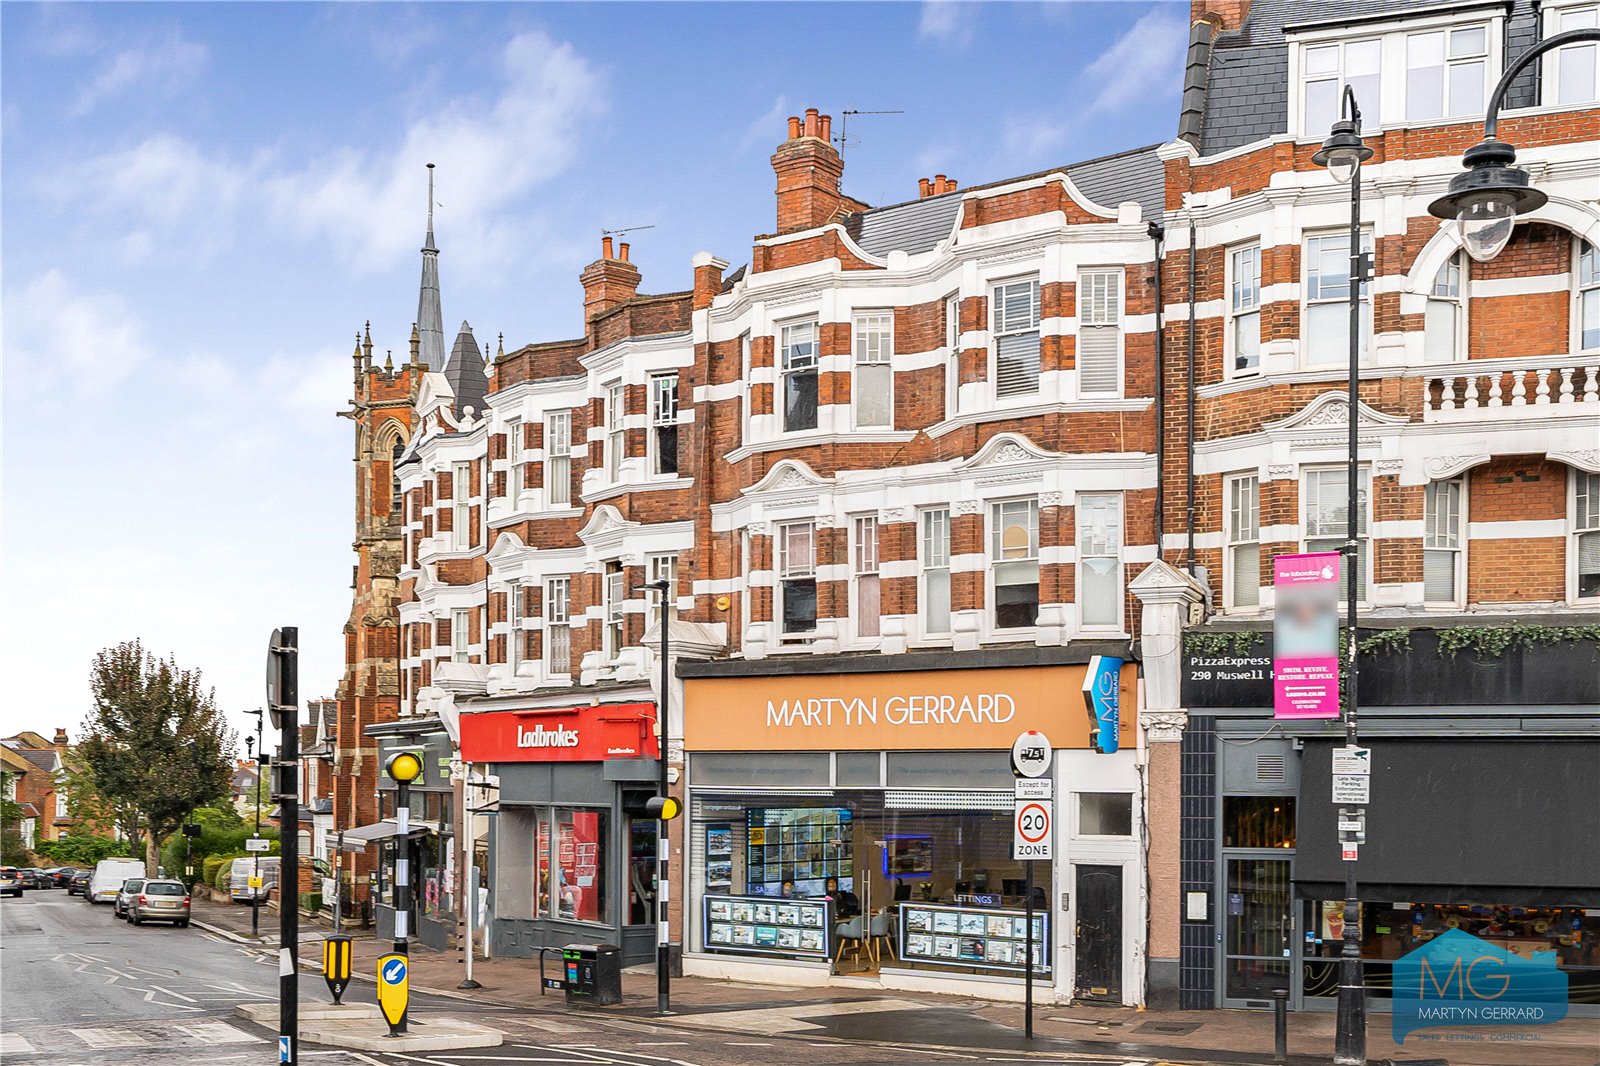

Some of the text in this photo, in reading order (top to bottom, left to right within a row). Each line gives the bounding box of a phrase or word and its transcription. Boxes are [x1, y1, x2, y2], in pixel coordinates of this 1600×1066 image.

[1190, 657, 1271, 668] PizzaExpress
[1190, 671, 1212, 680] 290
[1216, 669, 1264, 680] Muswell
[1098, 671, 1113, 722] MG
[765, 693, 1016, 727] MARTYN GERRARD
[517, 723, 579, 748] Ladbrokes
[1018, 780, 1050, 789] Except for
[1023, 815, 1045, 831] 20
[1018, 845, 1048, 856] ZONE
[953, 893, 993, 904] LETTINGS
